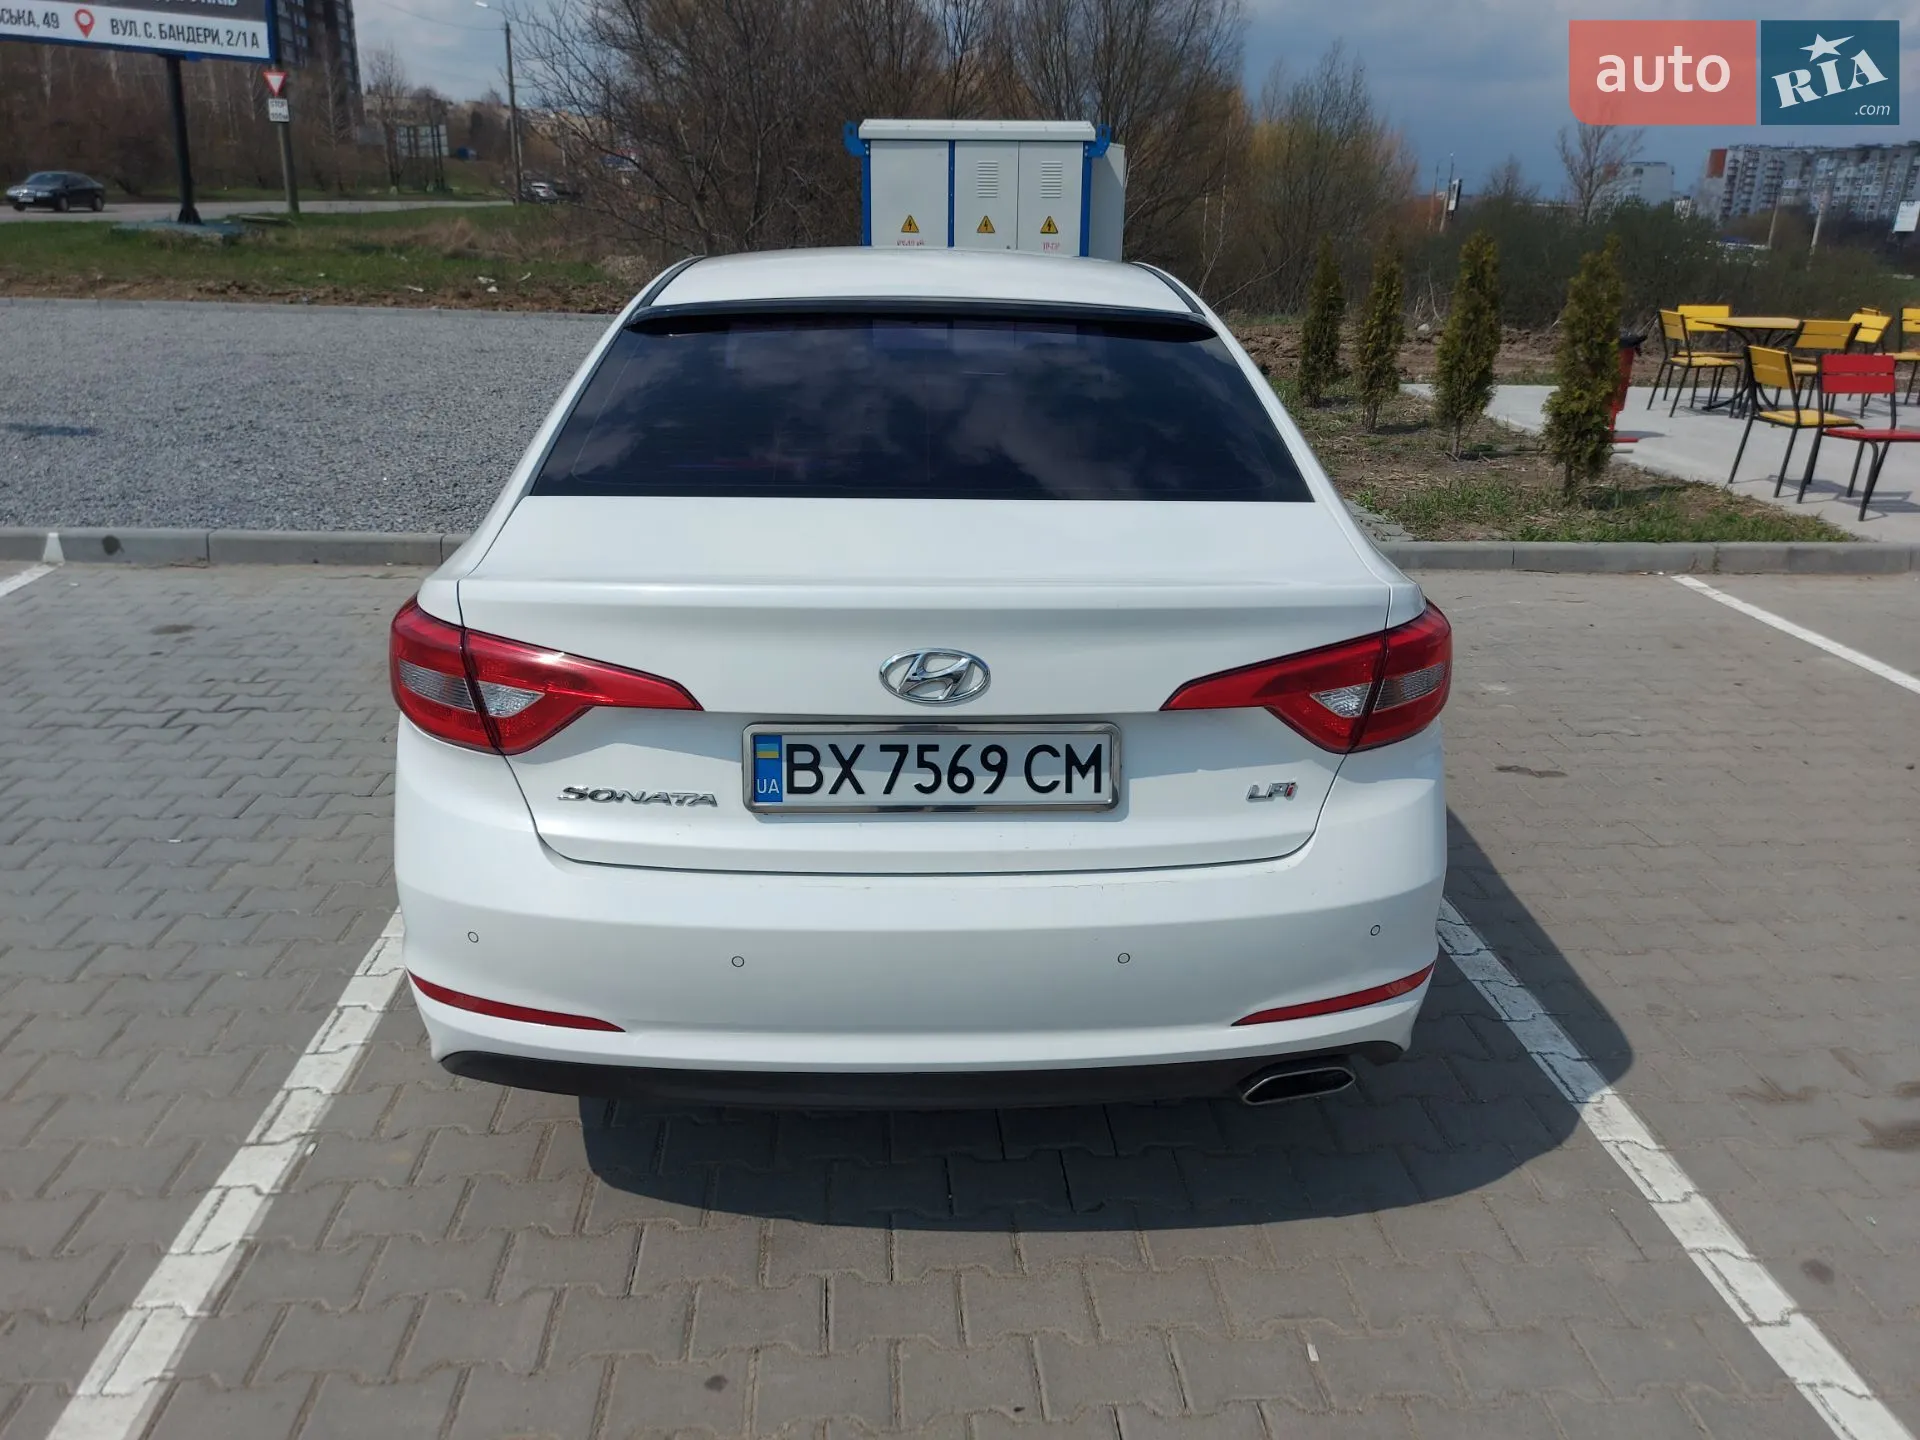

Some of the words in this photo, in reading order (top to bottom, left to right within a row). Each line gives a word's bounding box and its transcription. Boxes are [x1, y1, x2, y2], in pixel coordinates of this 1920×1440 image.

[0, 8, 40, 30] СЬКА,
[42, 12, 60, 29] 49
[110, 18, 141, 38] ВУЛ.
[143, 21, 156, 40] С.
[158, 23, 224, 48] БАНДЕРИ,
[786, 743, 865, 795] BX
[879, 743, 1009, 795] 7569
[1023, 743, 1103, 795] CM
[557, 785, 719, 808] SONATA
[756, 778, 780, 795] UA
